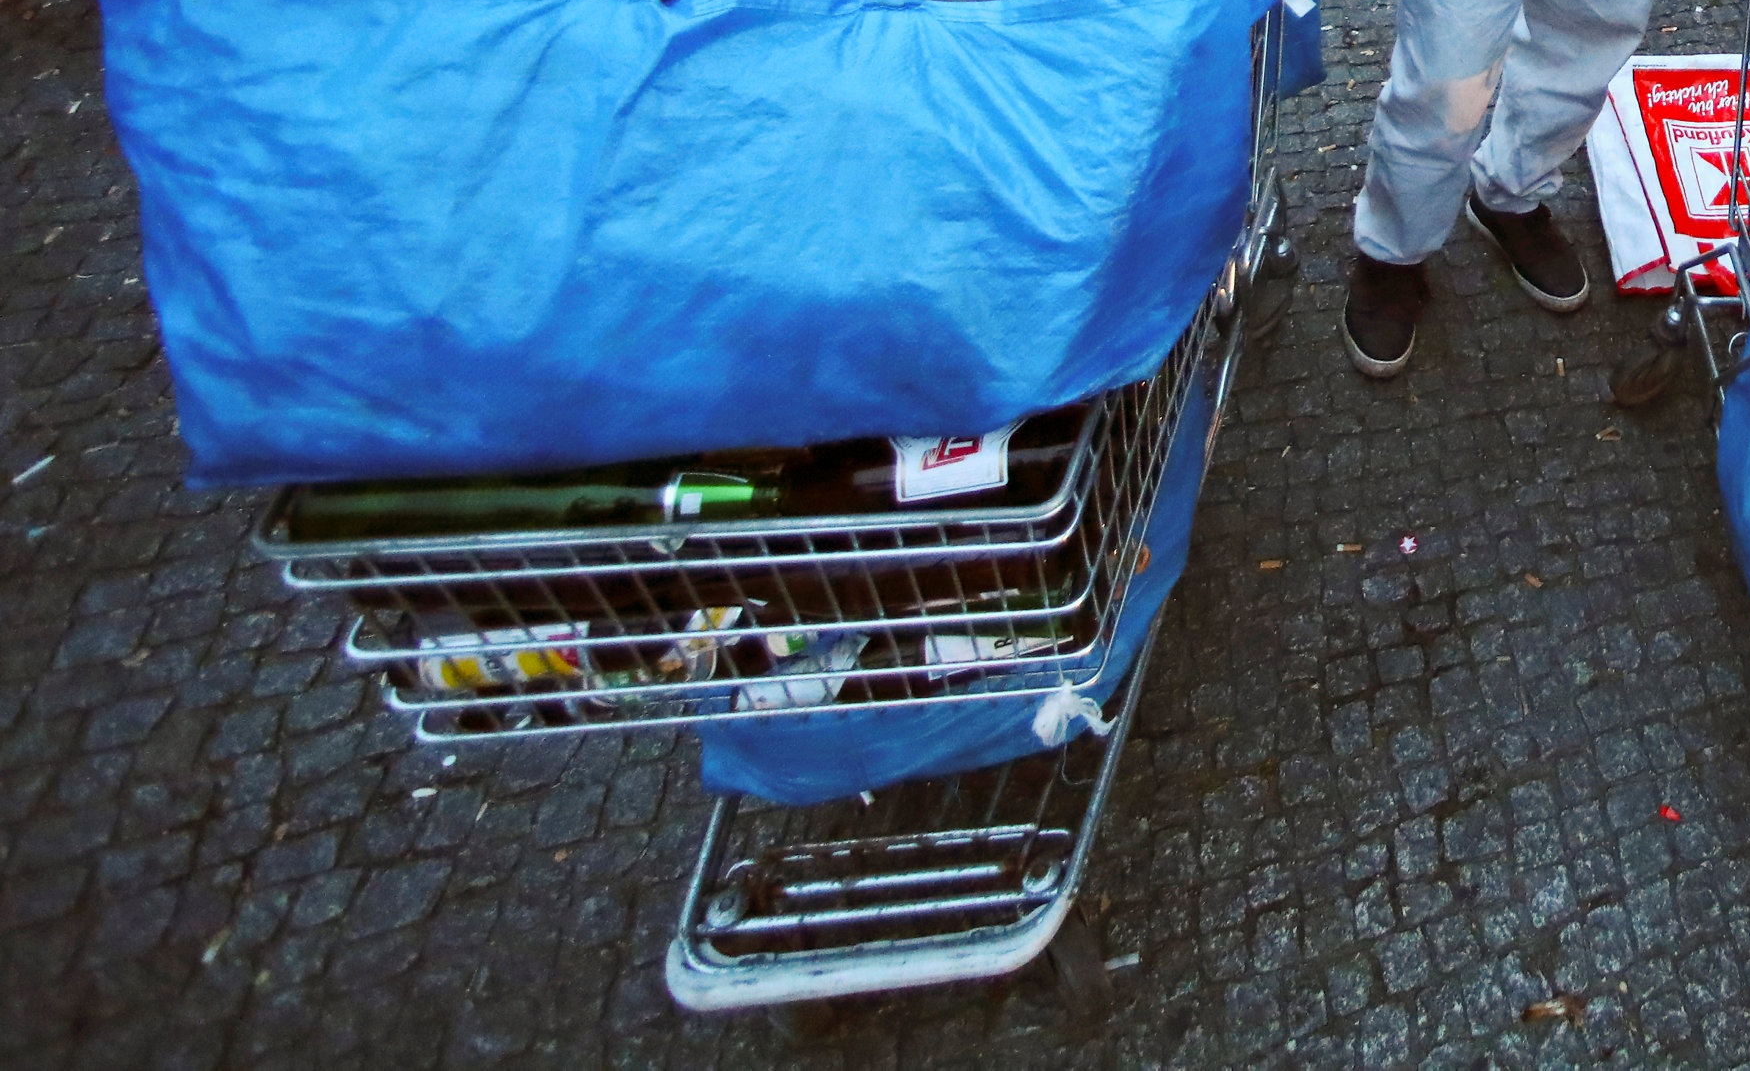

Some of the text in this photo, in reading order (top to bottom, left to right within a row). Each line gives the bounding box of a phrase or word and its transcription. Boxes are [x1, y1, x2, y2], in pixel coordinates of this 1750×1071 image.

[1647, 79, 1730, 108] ich richtig!
[1688, 97, 1715, 116] bin
